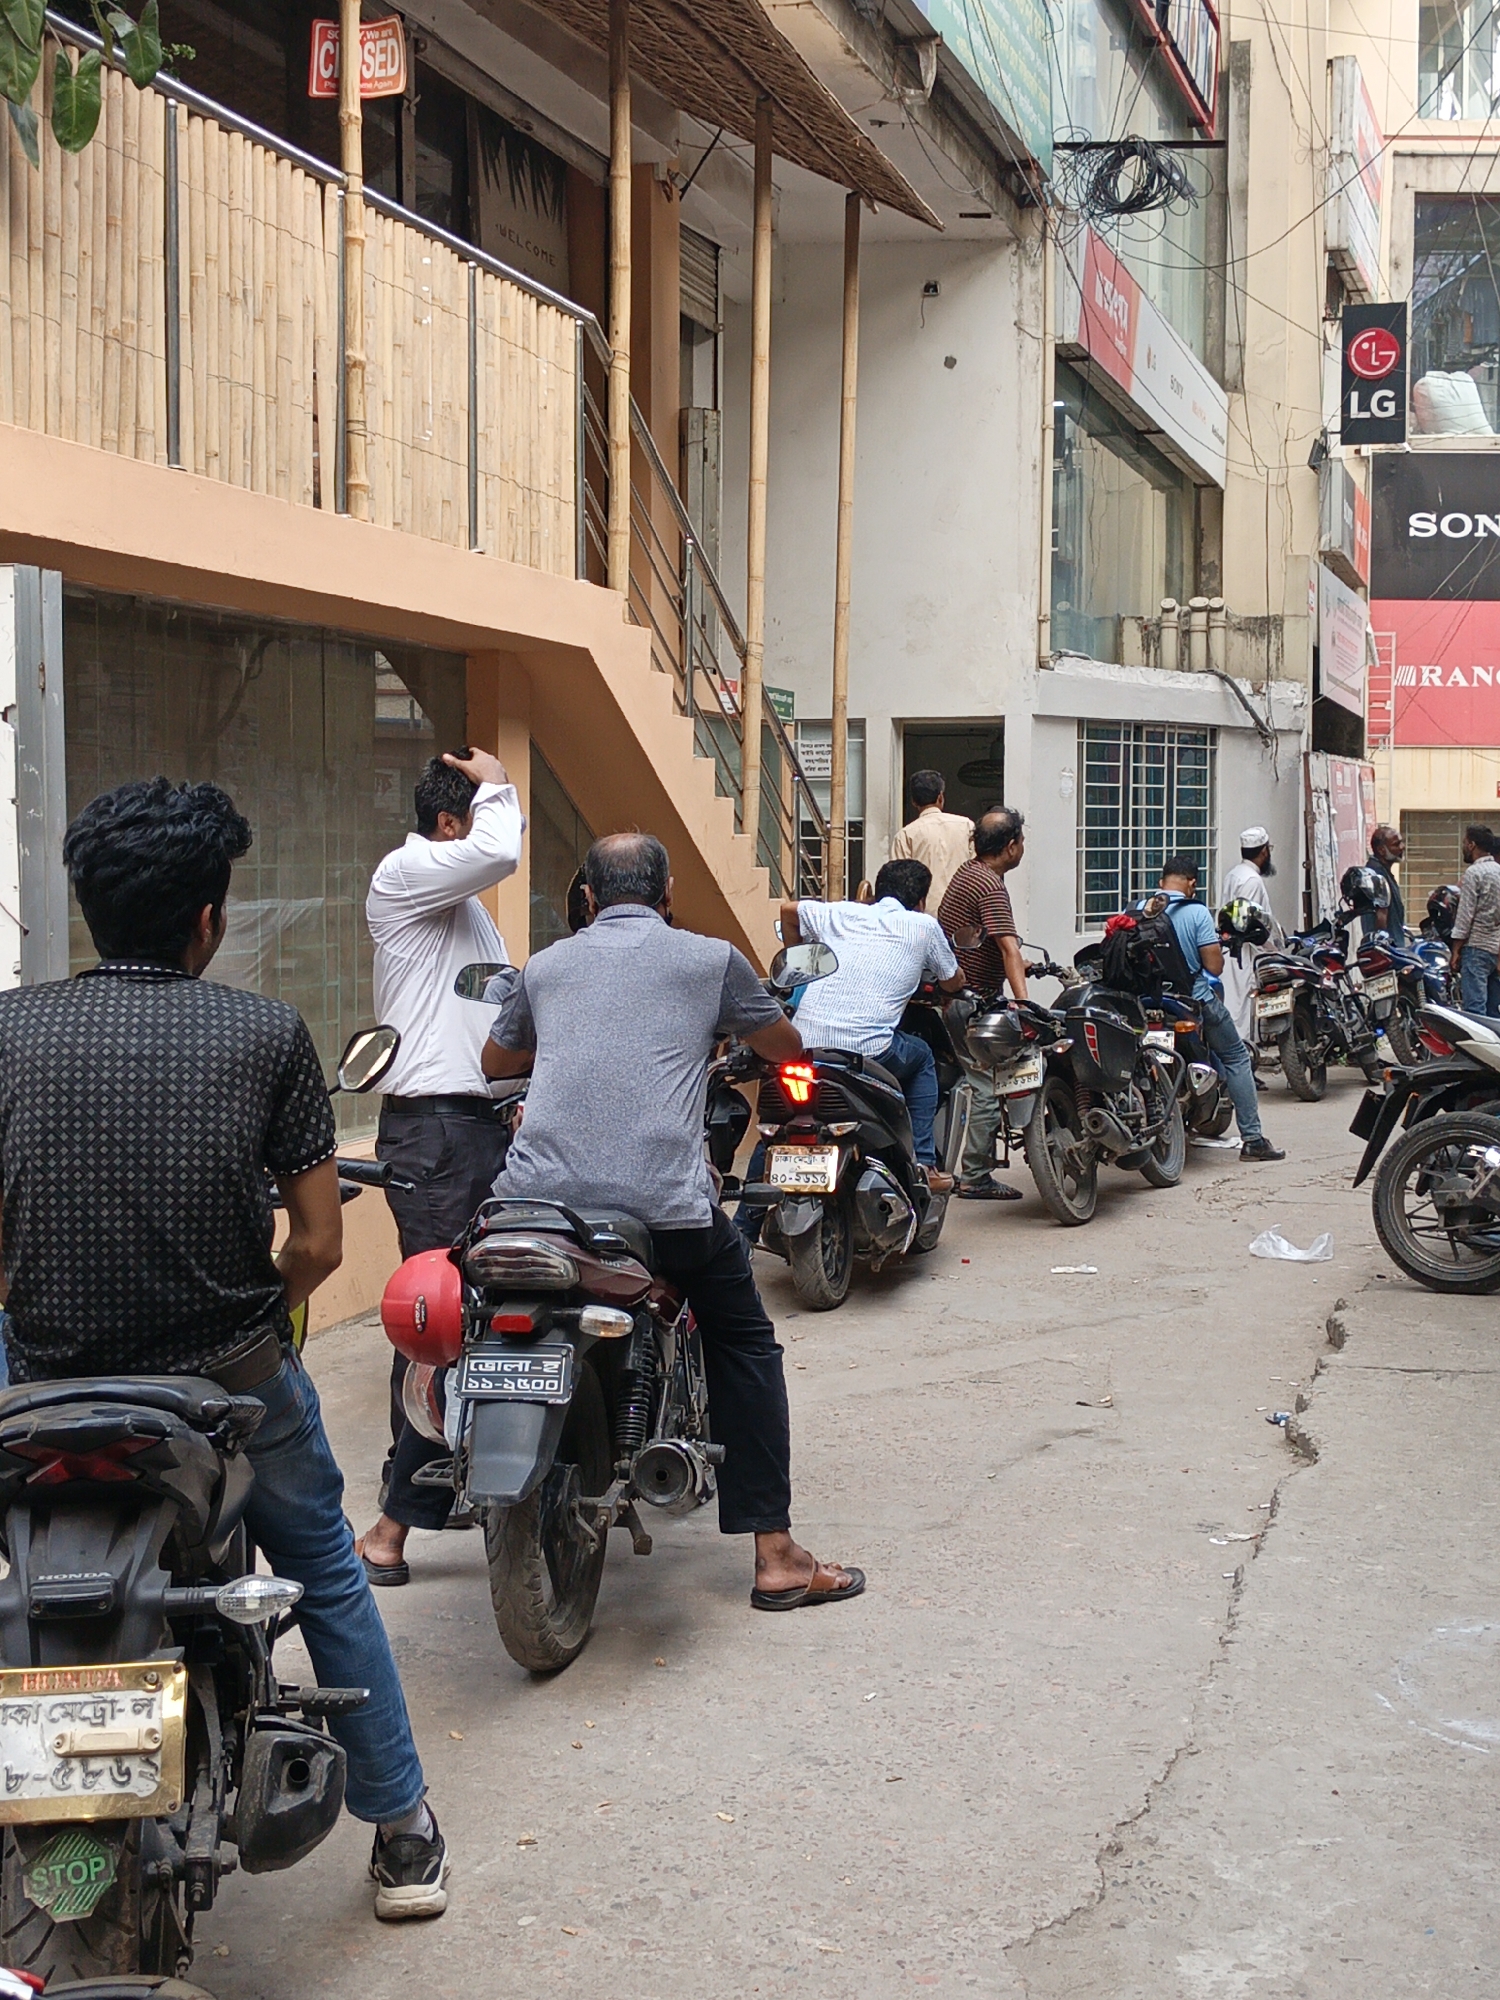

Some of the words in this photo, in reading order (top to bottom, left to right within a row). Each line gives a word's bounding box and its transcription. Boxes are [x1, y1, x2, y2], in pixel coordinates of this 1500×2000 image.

[319, 38, 399, 79] CLSED
[499, 223, 556, 267] WELCOME
[1350, 389, 1396, 419] LG
[1408, 511, 1500, 539] SON
[1419, 664, 1500, 688] RAN
[38, 1572, 112, 1580] HONDA
[31, 1856, 106, 1891] STOP
